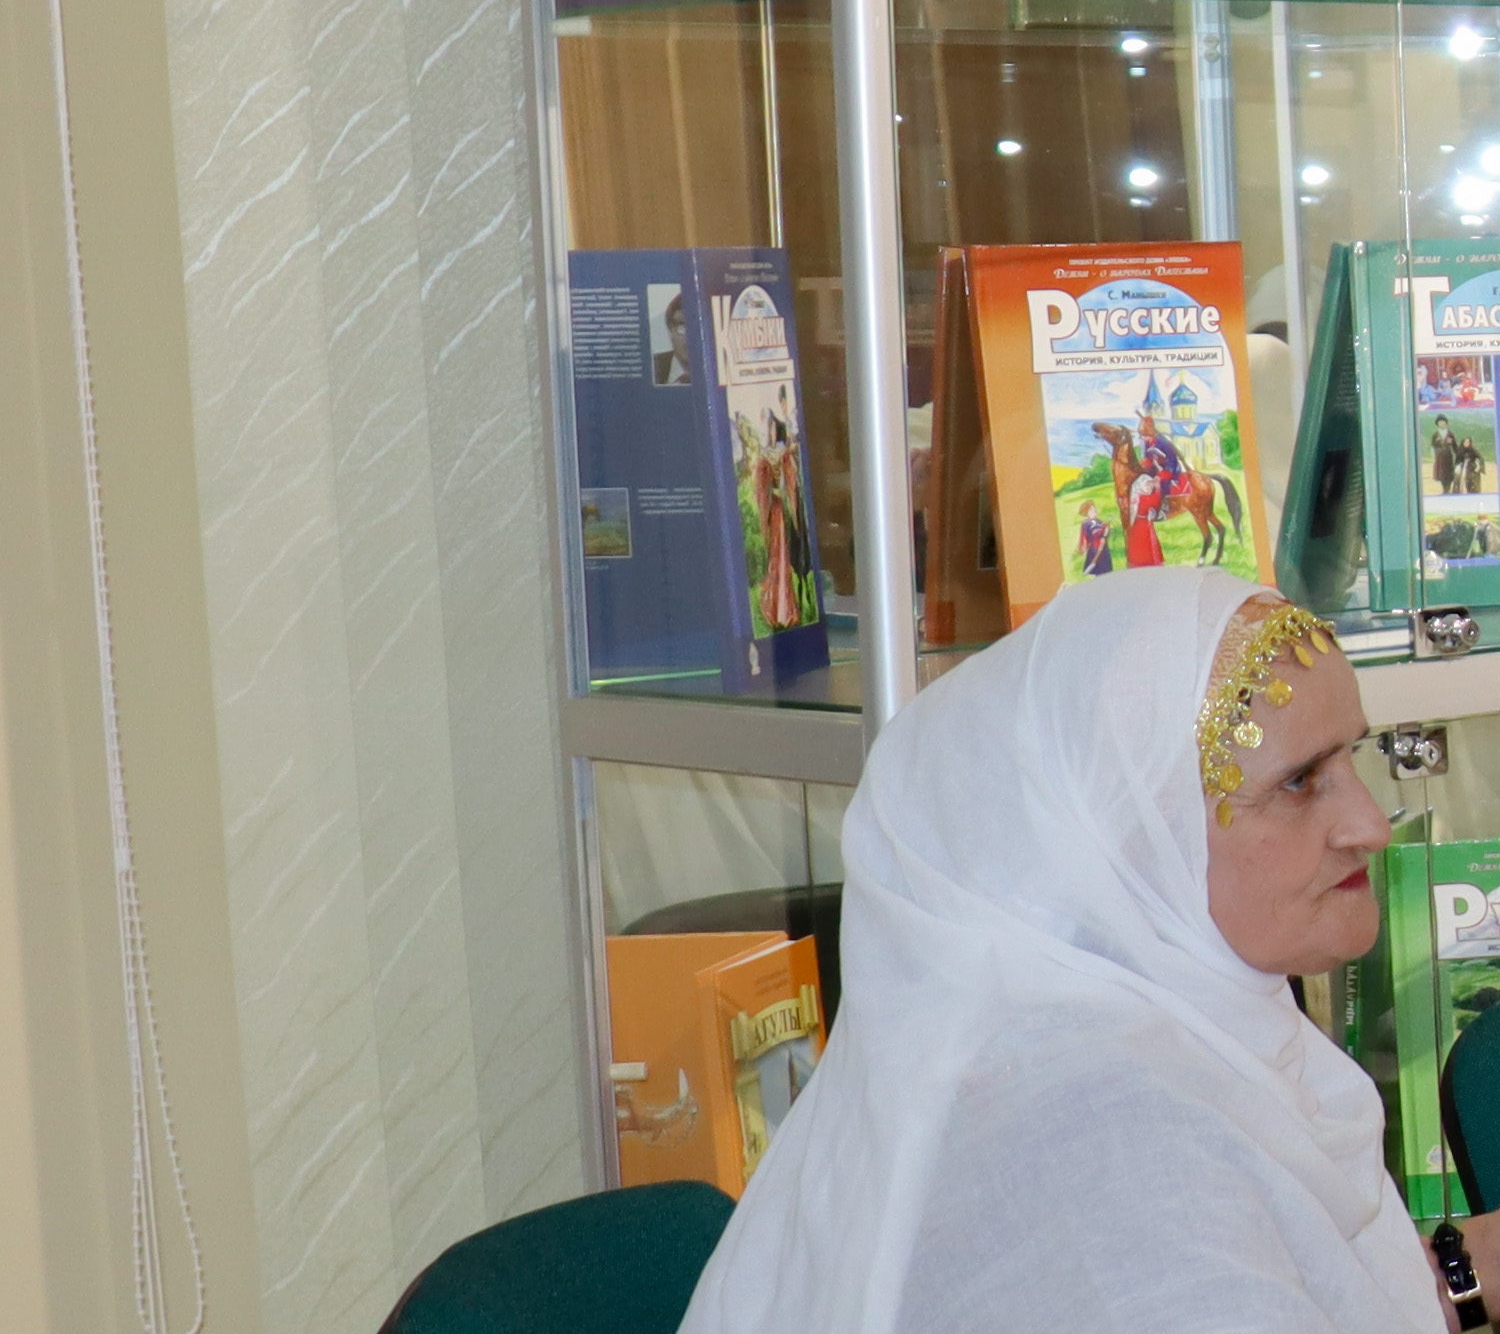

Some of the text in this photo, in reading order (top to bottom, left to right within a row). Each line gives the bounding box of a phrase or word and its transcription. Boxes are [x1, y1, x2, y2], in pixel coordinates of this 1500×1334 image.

[711, 295, 787, 386] Кумыки
[1026, 289, 1221, 373] Русские
[1056, 352, 1218, 367] ИСТОРИЯ, КУЛЬТУРА, ТРАДИЦИИ
[752, 1005, 802, 1049] АГУЛЫ
